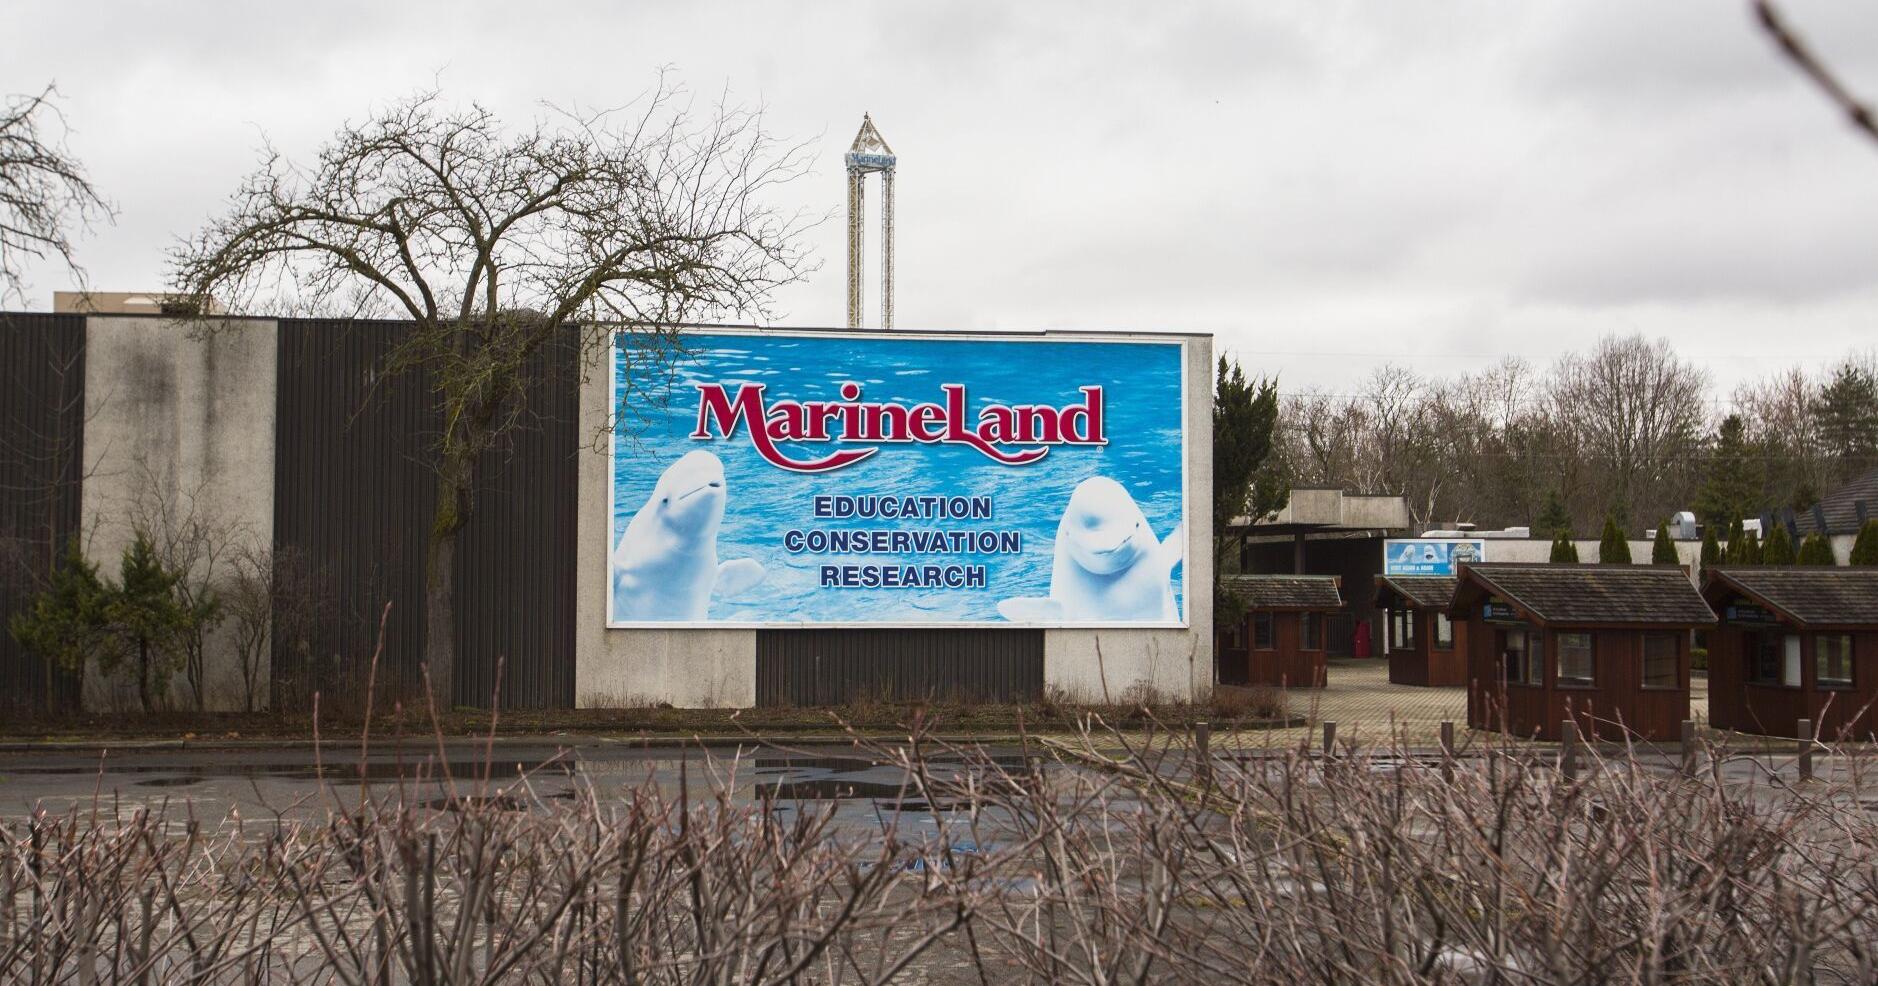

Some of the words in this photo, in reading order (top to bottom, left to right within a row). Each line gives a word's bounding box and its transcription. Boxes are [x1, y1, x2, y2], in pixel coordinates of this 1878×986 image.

[690, 383, 1107, 472] MarineLand
[814, 496, 991, 518] EDUCATION
[783, 530, 1020, 553] CONSERVATION
[820, 565, 985, 588] RESEARCH
